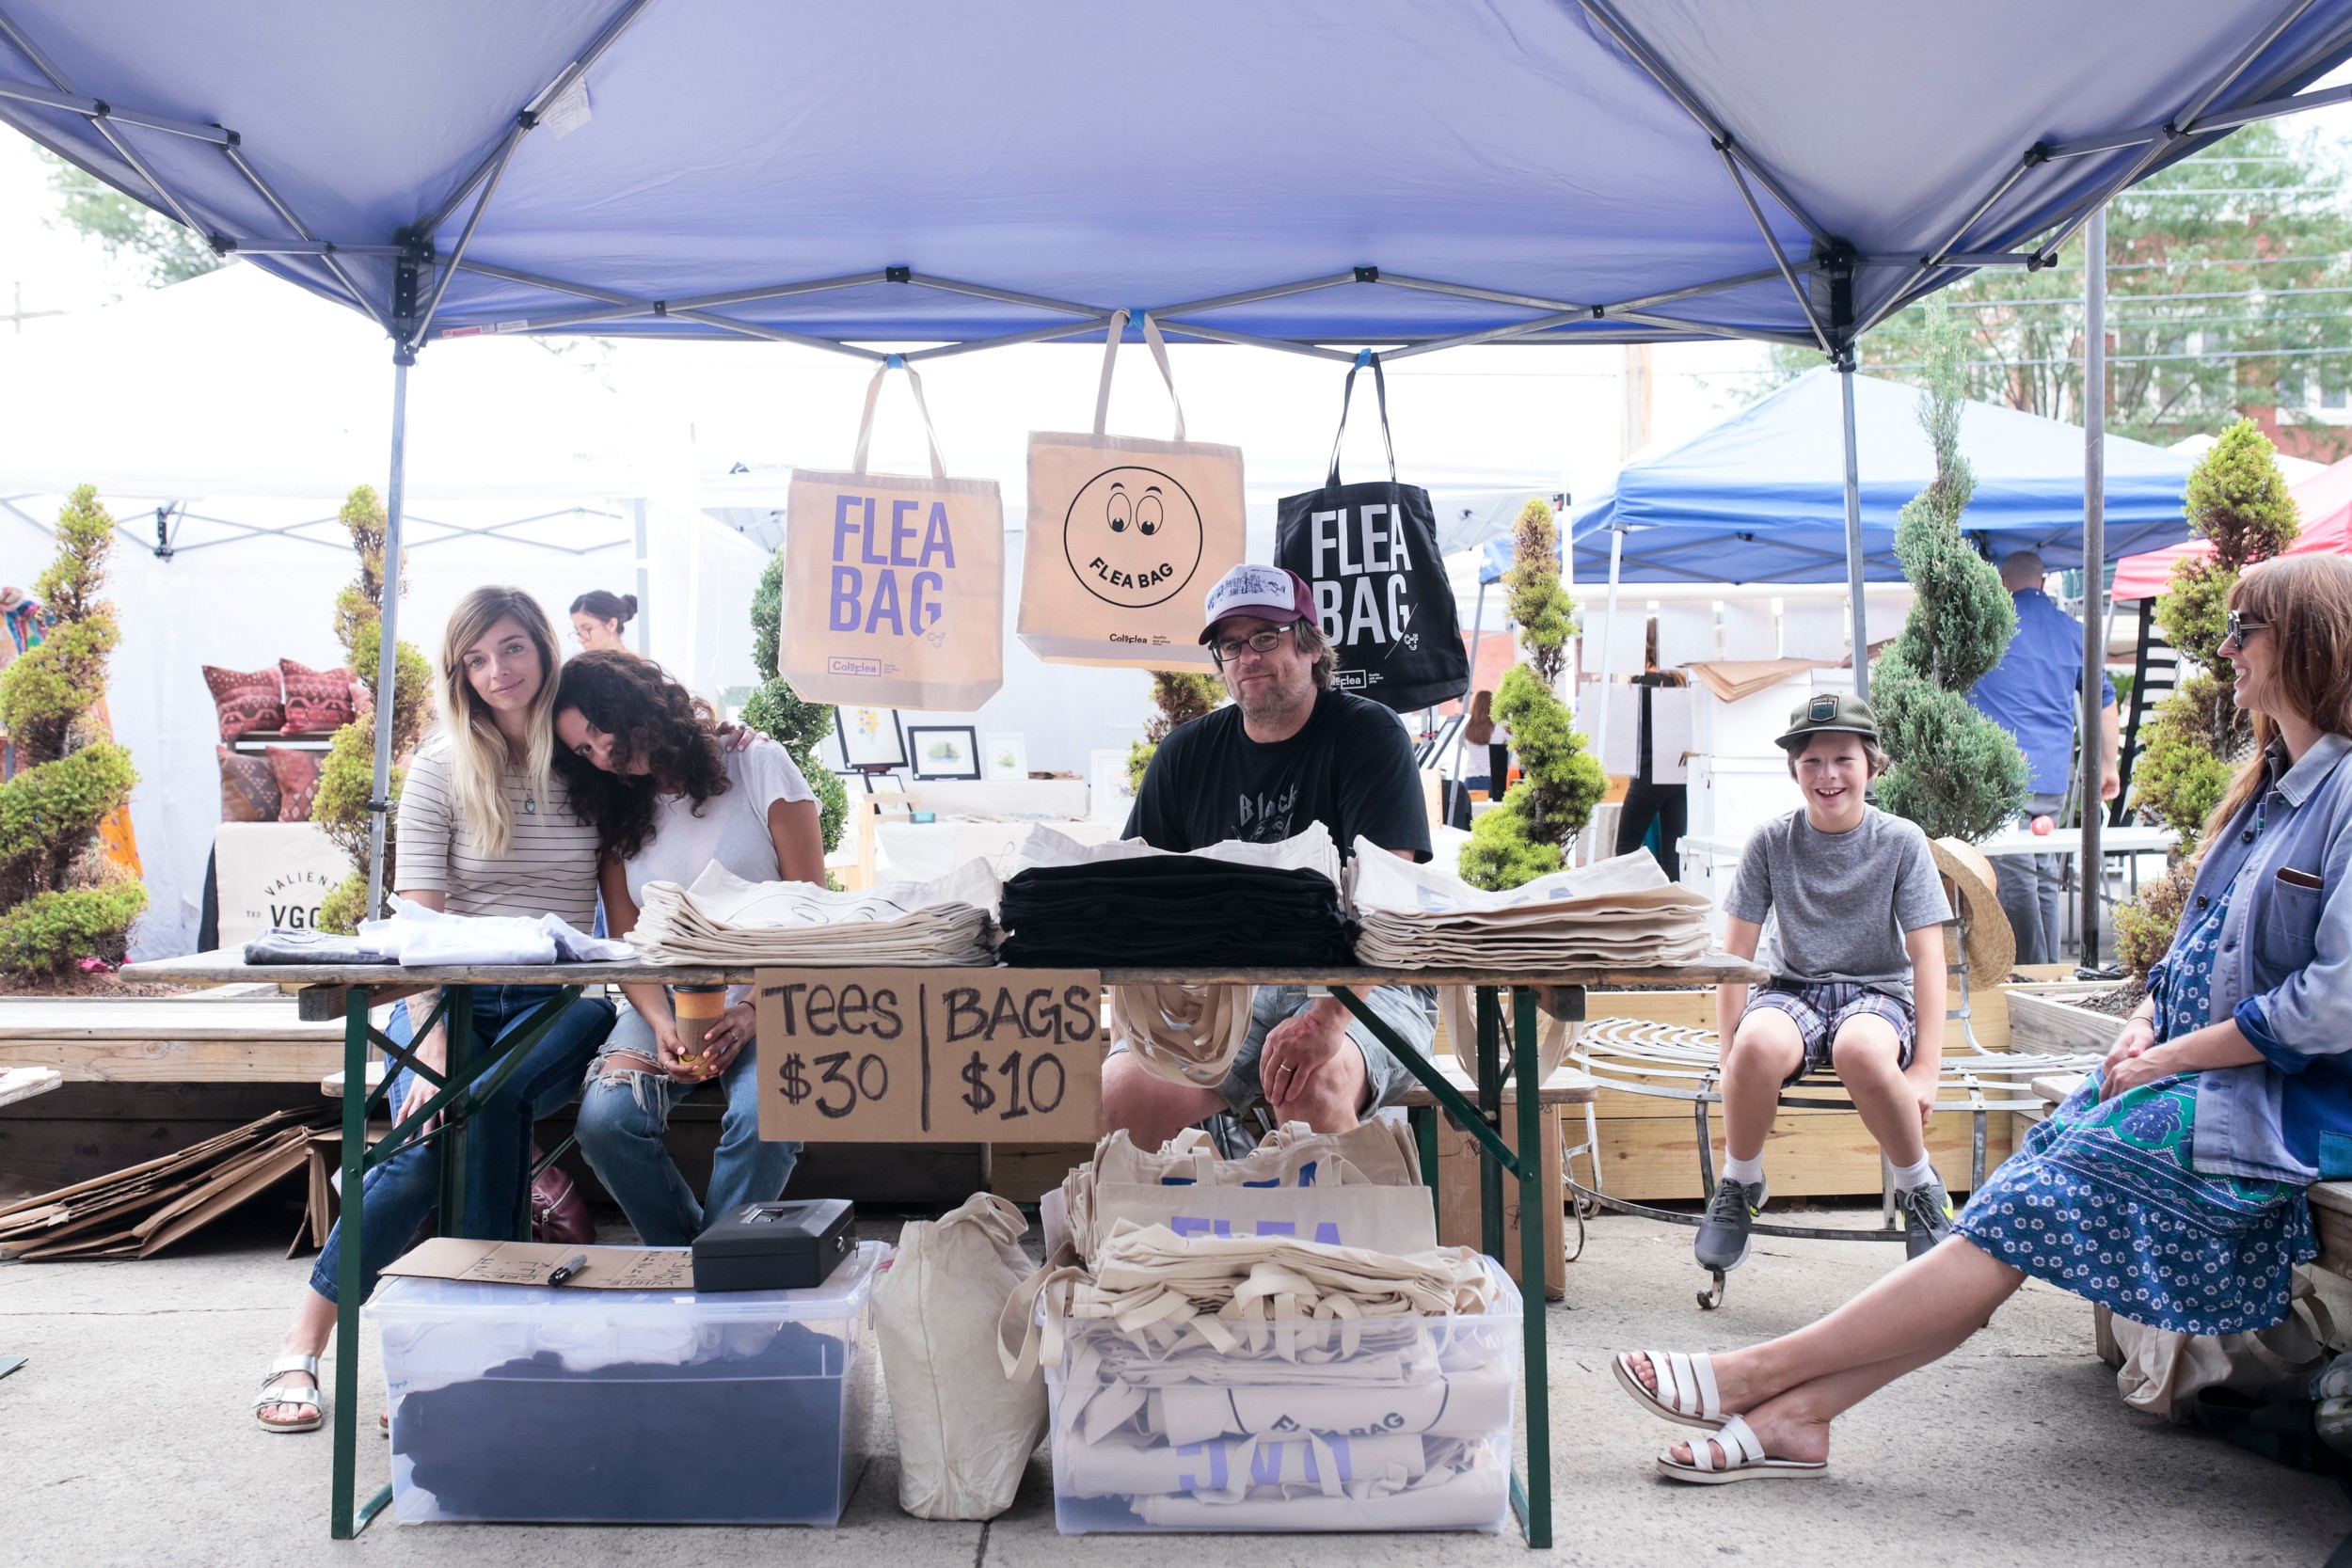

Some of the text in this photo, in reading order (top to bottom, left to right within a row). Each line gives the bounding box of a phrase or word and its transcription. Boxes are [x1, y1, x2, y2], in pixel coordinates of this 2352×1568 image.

[833, 495, 956, 569] FLEA
[1311, 503, 1413, 578] FLEA
[829, 565, 944, 637] BAG
[1089, 556, 1173, 589] FLEA BAG
[1312, 573, 1411, 646] BAG
[1329, 674, 1361, 689] lsFlea
[942, 985, 1096, 1044] BAGS
[779, 1051, 889, 1119] $30
[961, 1050, 1066, 1121] $10
